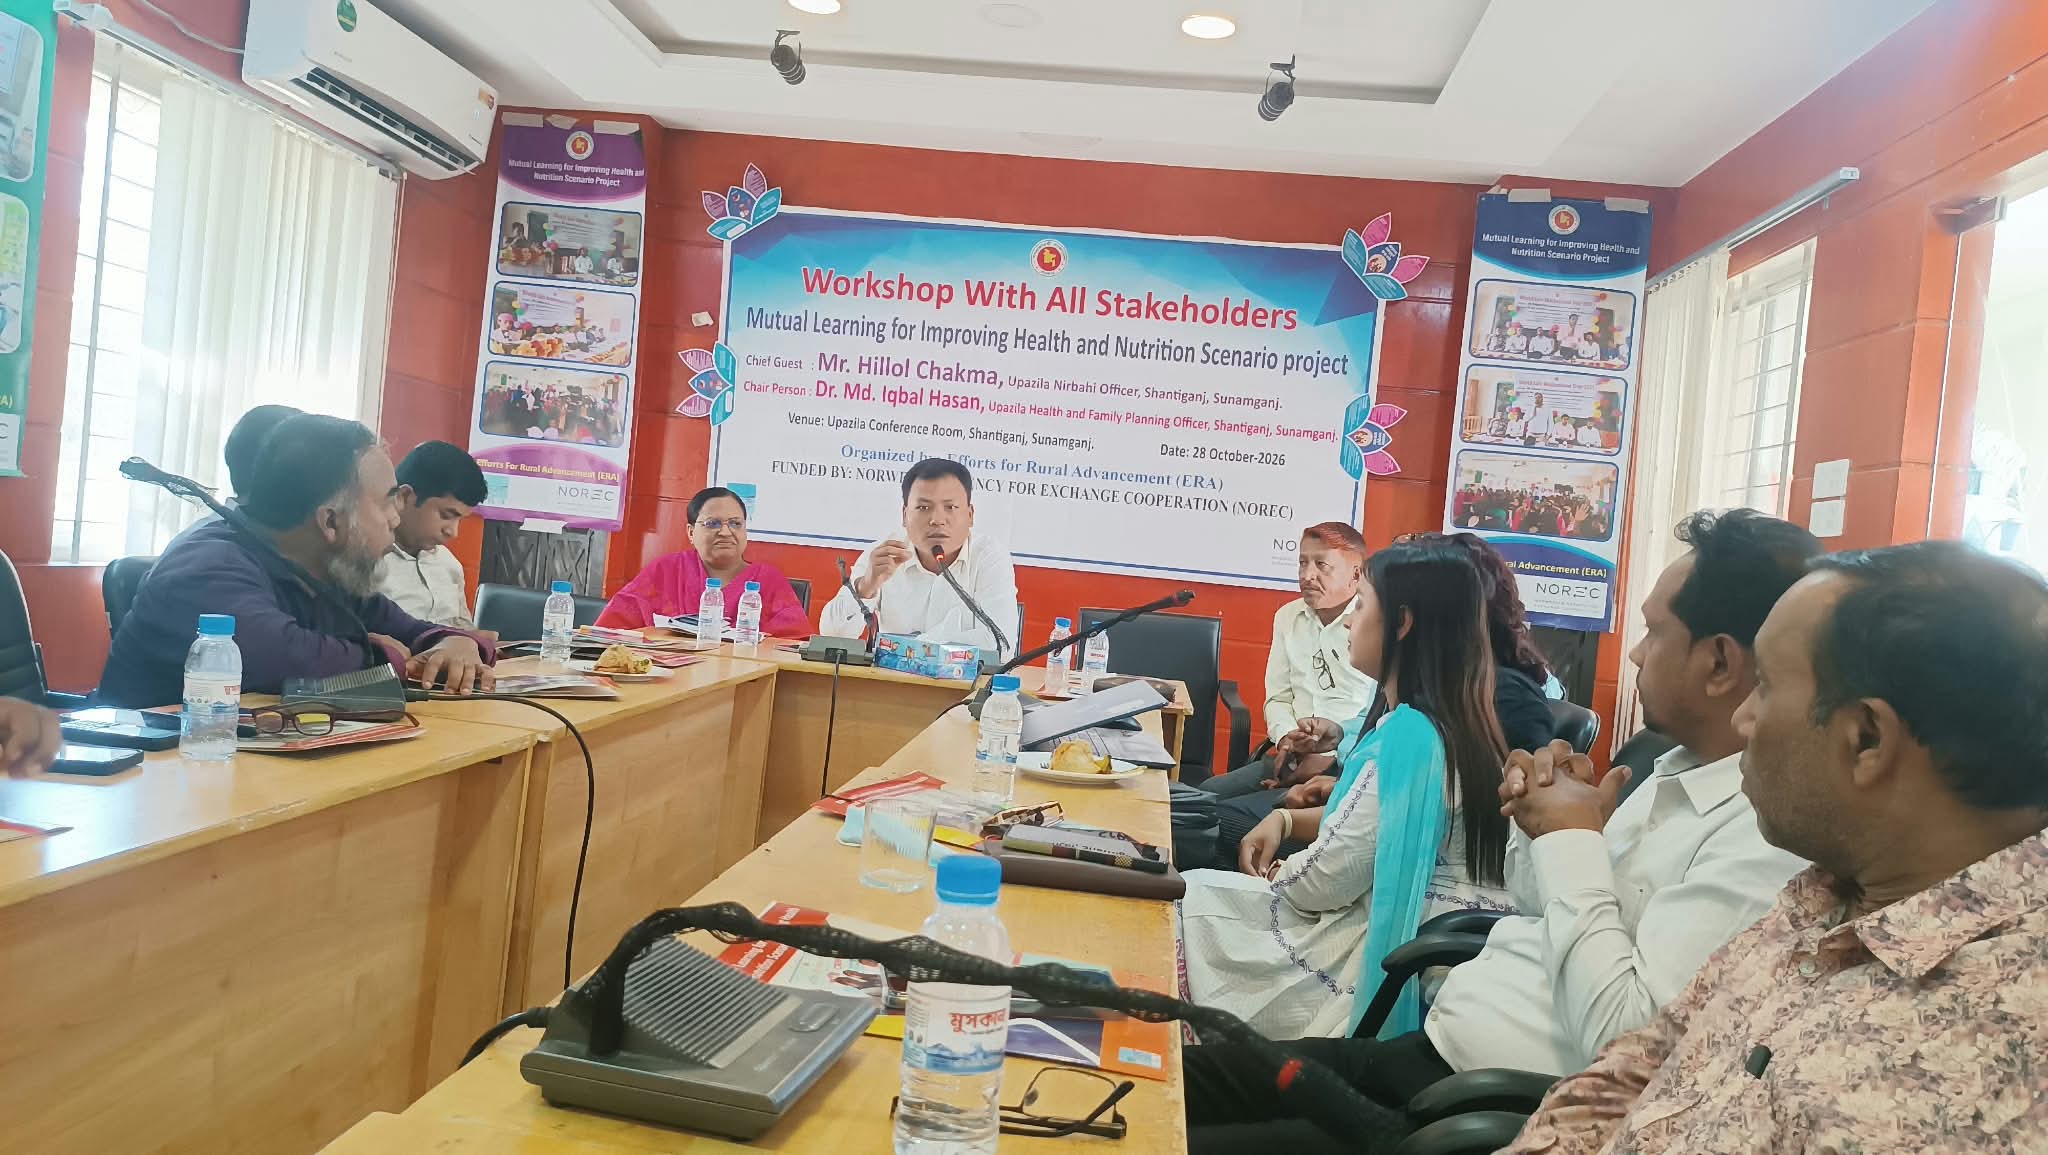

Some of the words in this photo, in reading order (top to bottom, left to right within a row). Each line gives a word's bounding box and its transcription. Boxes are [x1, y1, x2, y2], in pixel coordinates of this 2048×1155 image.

[533, 160, 562, 171] Learning
[564, 162, 573, 170] for
[575, 163, 610, 175] Improving
[611, 166, 633, 176] Health
[595, 177, 620, 187] Project
[1482, 233, 1509, 242] Mutual
[1511, 235, 1545, 247] Learning
[1546, 238, 1557, 246] for
[1559, 239, 1598, 251] Improving
[1600, 243, 1624, 253] Health
[1626, 246, 1640, 255] and
[1511, 247, 1546, 258] Nutrition
[1547, 250, 1581, 261] Scenario
[1583, 253, 1610, 264] Project
[802, 267, 954, 309] Workshop
[965, 279, 1036, 311] With
[1046, 286, 1086, 315] All
[1095, 289, 1298, 331] Stakeholders
[746, 306, 808, 333] Mutual
[813, 311, 887, 343] Learning
[891, 317, 916, 341] for
[921, 320, 1009, 353] Improving
[1014, 327, 1071, 354] Health
[1076, 333, 1110, 357] and
[1115, 335, 1195, 364] Nutrition
[1201, 342, 1278, 370] Scenario
[1283, 352, 1349, 378] project
[746, 354, 771, 368] Chief
[773, 357, 803, 370] Guest
[818, 353, 851, 374] Mr.
[858, 356, 910, 377] Hillol
[916, 360, 1004, 389] Chakma,
[1008, 376, 1050, 393] Upazila
[1053, 378, 1097, 394] Nirbahi
[1099, 383, 1141, 399] Officer,
[1144, 386, 1209, 405] Shantiganj,
[1213, 392, 1283, 411] Sunamganj.
[744, 380, 770, 393] Chair
[772, 383, 806, 397] Person
[815, 380, 838, 400] Dr.
[844, 382, 876, 402] Md.
[882, 384, 924, 411] Iqbal
[929, 390, 985, 414] Hasan,
[988, 400, 1026, 417] Upazila
[1029, 402, 1063, 417] Health
[1066, 407, 1086, 420] and
[1088, 409, 1122, 425] Family
[1125, 411, 1170, 429] Planning
[1173, 415, 1211, 432] Officer,
[1214, 419, 1273, 438] Shantiganj,
[1275, 425, 1338, 442] Sunamganj.
[788, 412, 824, 428] Venue:
[827, 415, 866, 431] Upazila
[869, 418, 929, 436] Conference
[932, 423, 966, 440] Room,
[969, 426, 1028, 446] Shantiganj,
[1031, 434, 1095, 451] Sunamganj.
[1160, 444, 1190, 459] Date:
[1193, 445, 1206, 460] 28
[1209, 448, 1286, 467] October-2026
[519, 464, 540, 473] Rural
[541, 466, 596, 479] Advancement
[597, 471, 620, 482] (ERA)
[841, 444, 914, 463] Organized
[1000, 457, 1022, 472] for
[1026, 459, 1068, 477] Rural
[1071, 464, 1172, 487] Advancement
[1175, 472, 1224, 492] (ERA)
[558, 485, 615, 501] NOREC
[771, 460, 827, 477] FUNDED
[830, 464, 852, 480] BY:
[971, 476, 1003, 492] NCY
[1008, 481, 1037, 496] FOR
[1040, 483, 1120, 504] EXCHANGE
[1123, 490, 1229, 514] COOPERATION
[1232, 500, 1295, 522] (NOREC)
[1517, 561, 1580, 575] Advancement
[1581, 568, 1607, 578] (ERA)
[1536, 582, 1600, 599] NOREC
